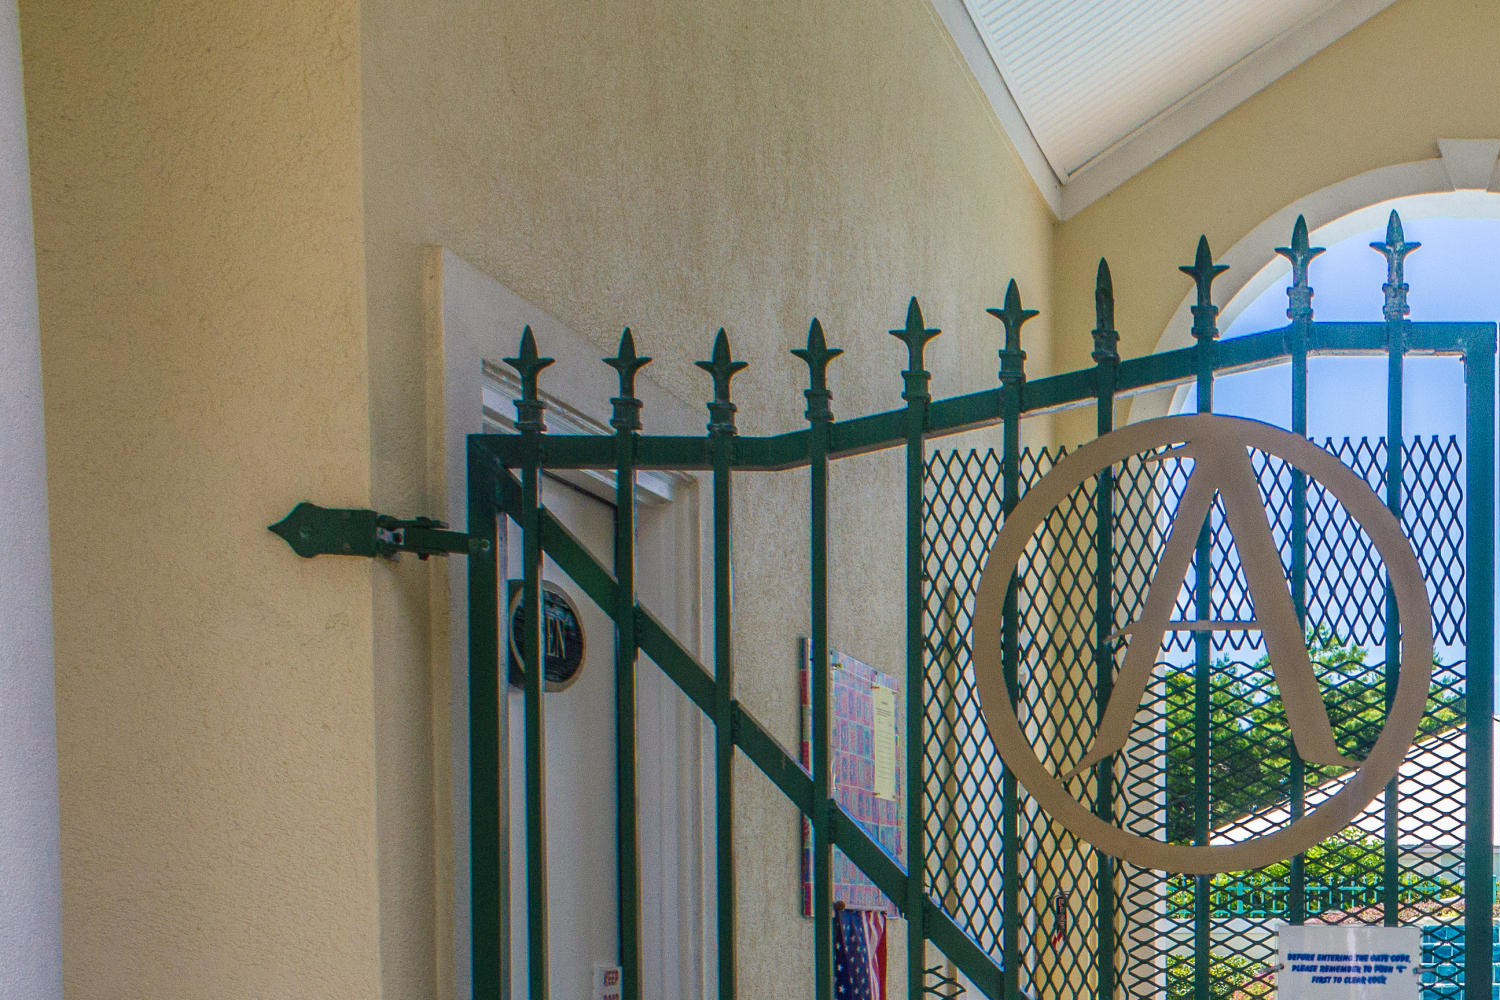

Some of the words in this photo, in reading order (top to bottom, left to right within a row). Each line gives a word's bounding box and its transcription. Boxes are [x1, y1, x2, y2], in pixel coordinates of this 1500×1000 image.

[1355, 954, 1369, 962] THE
[1291, 964, 1318, 972] PLEASE
[1363, 965, 1373, 973] TO
[1311, 976, 1332, 984] FIRST
[1333, 976, 1343, 984] TO
[1343, 976, 1367, 985] CLEAR
